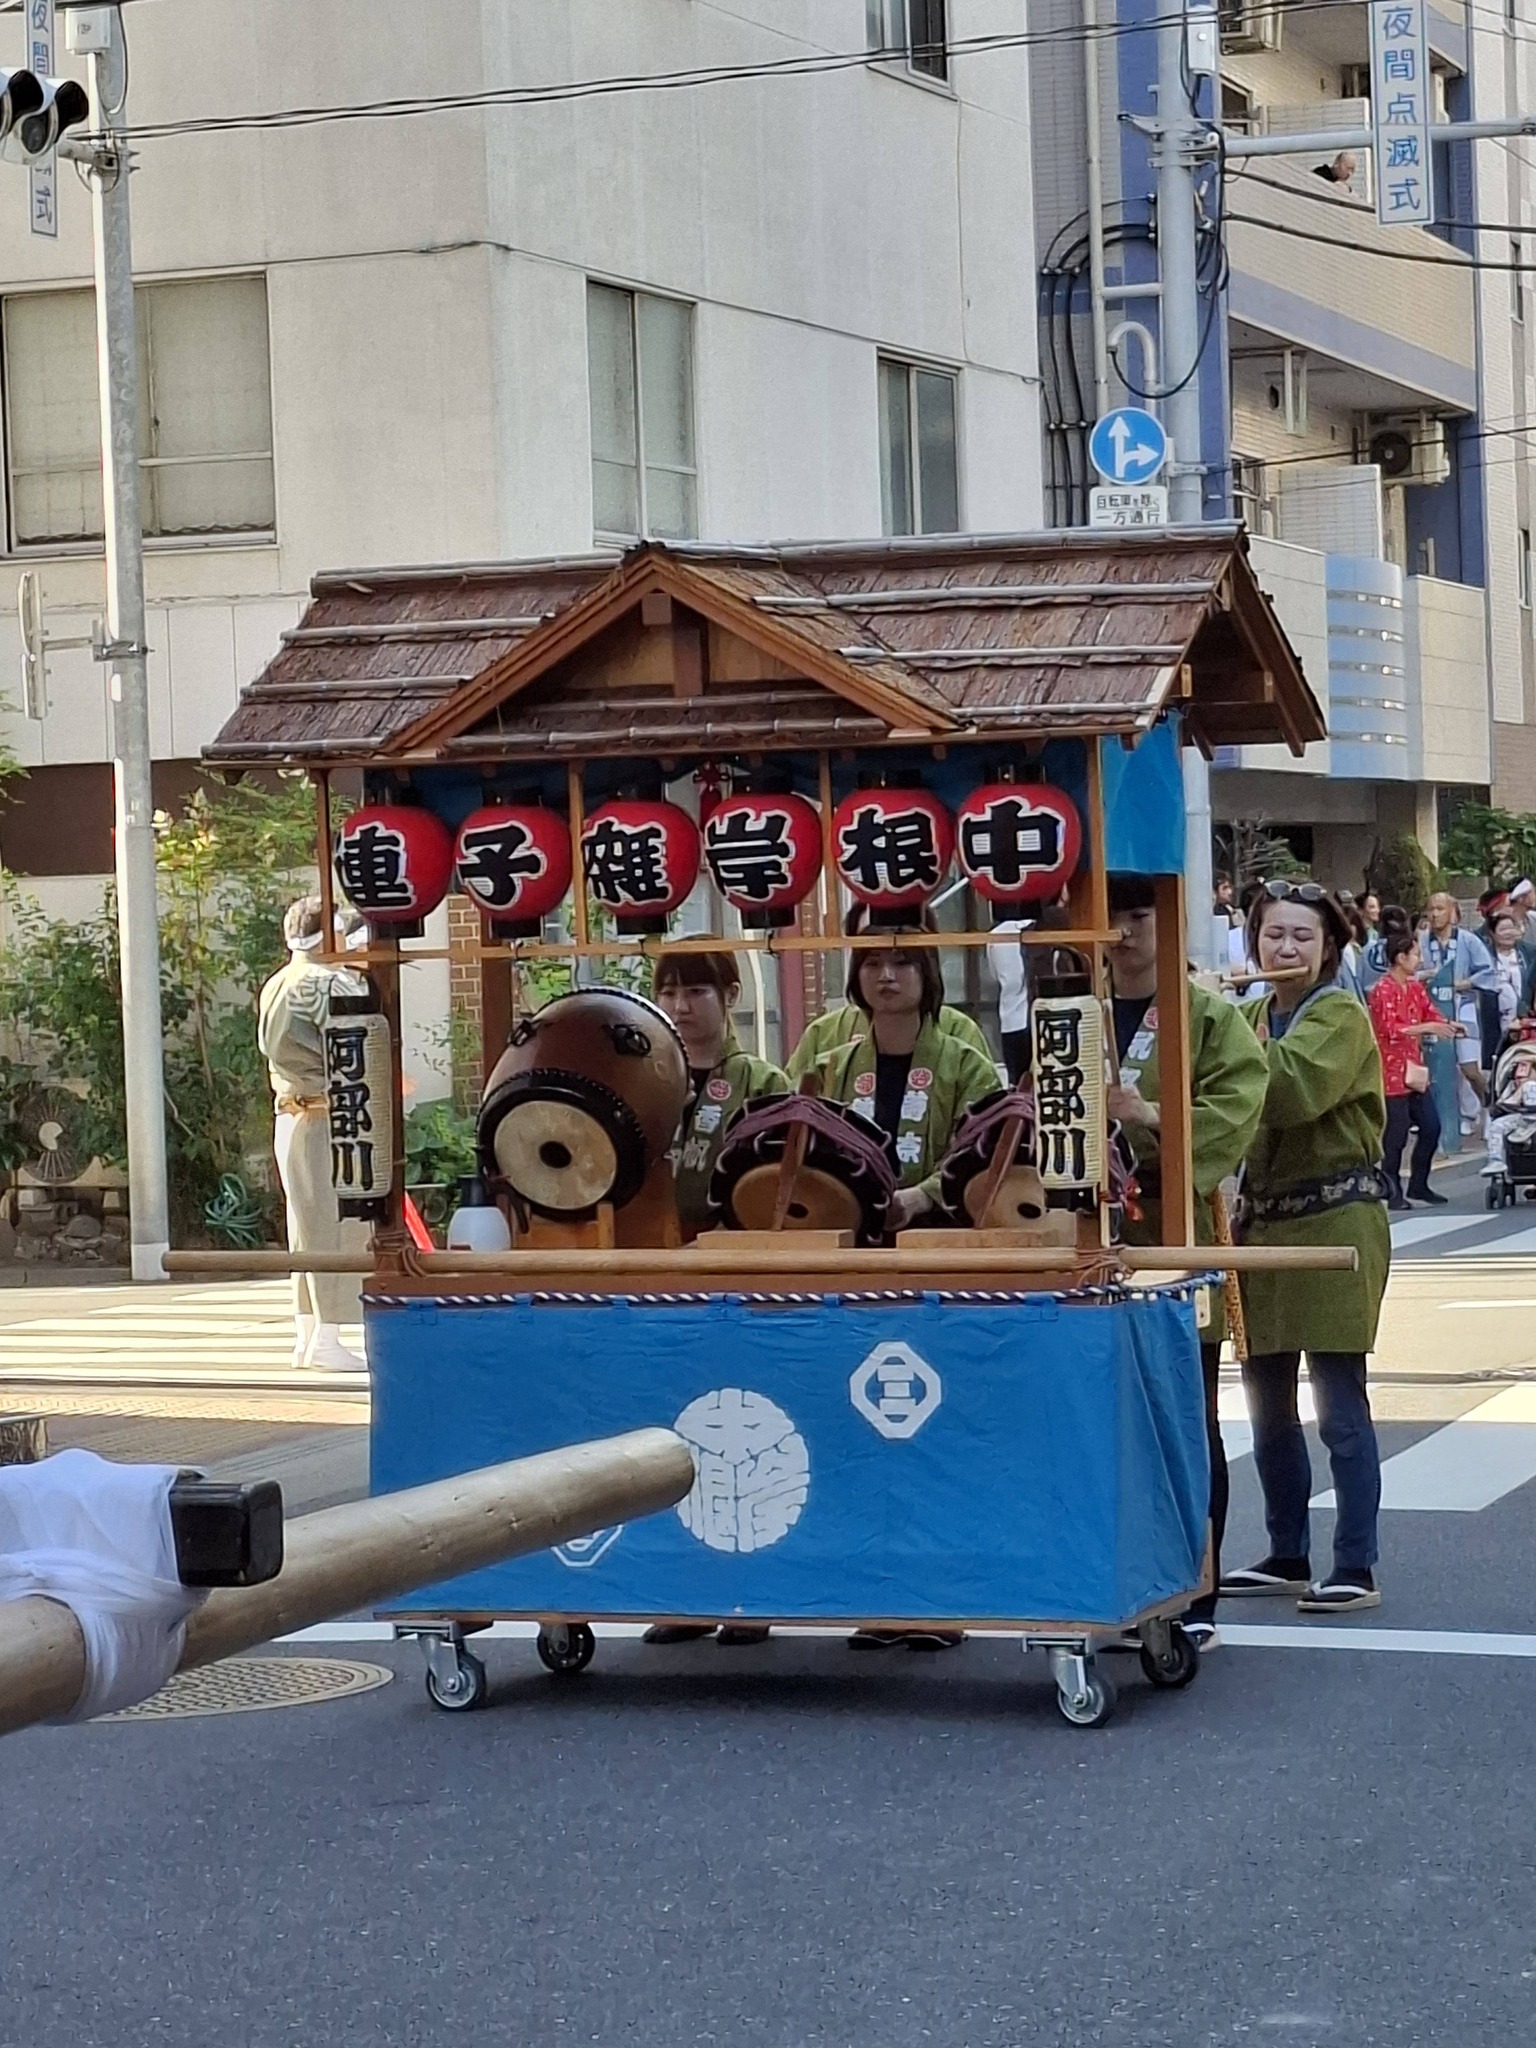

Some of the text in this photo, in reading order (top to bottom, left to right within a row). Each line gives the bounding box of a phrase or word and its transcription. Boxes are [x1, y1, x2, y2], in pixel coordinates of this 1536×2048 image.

[32, 0, 52, 224] 夜間式
[1382, 6, 1420, 211] 夜間点滅式
[1096, 510, 1160, 525] 一方通行
[457, 824, 552, 906] 子
[703, 810, 794, 900] 岸
[840, 807, 938, 890] 根
[960, 798, 1064, 886] 中
